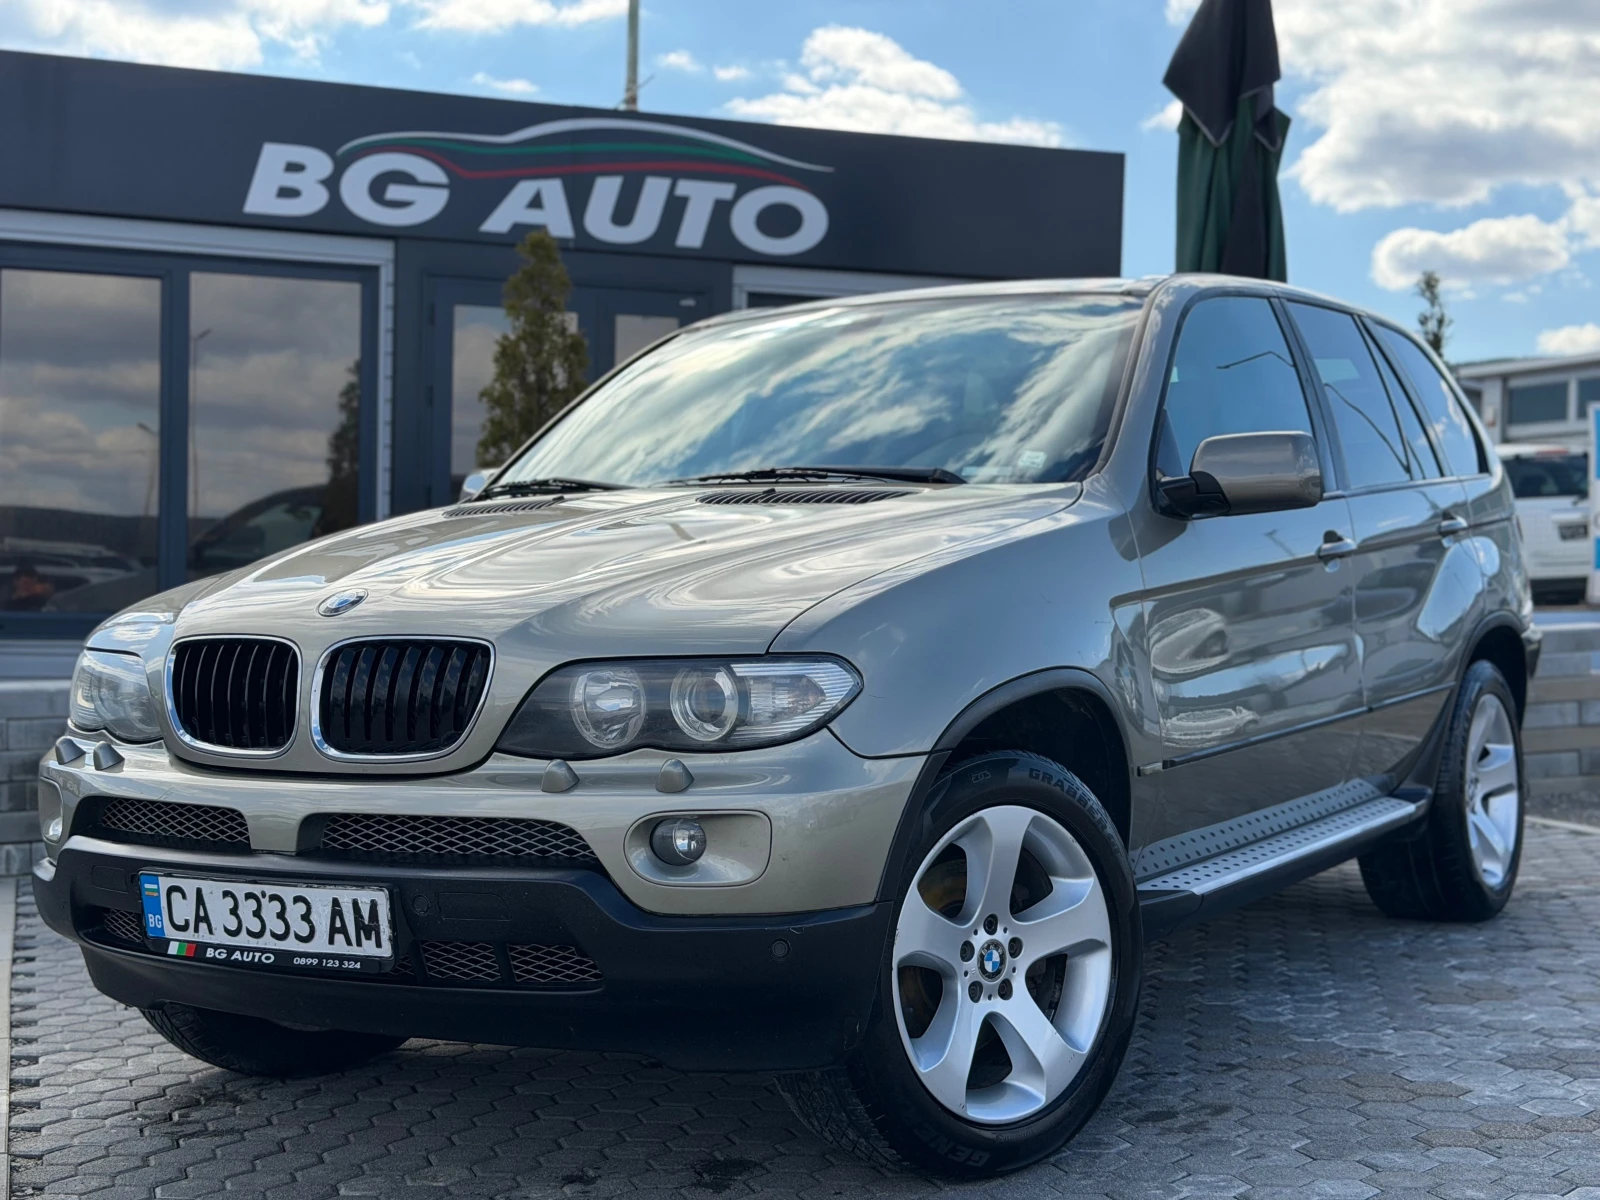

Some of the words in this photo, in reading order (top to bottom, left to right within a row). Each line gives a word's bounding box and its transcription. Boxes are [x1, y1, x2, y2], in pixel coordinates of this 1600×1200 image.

[242, 141, 450, 227] BG
[478, 173, 830, 256] AUTO
[148, 912, 163, 929] BG
[166, 884, 215, 935] CA
[222, 889, 316, 944] 3333
[328, 896, 383, 949] AM
[205, 947, 228, 959] BG
[230, 949, 275, 963] AUTO
[293, 956, 319, 967] 0899
[321, 958, 340, 968] 123
[341, 960, 361, 970] 324
